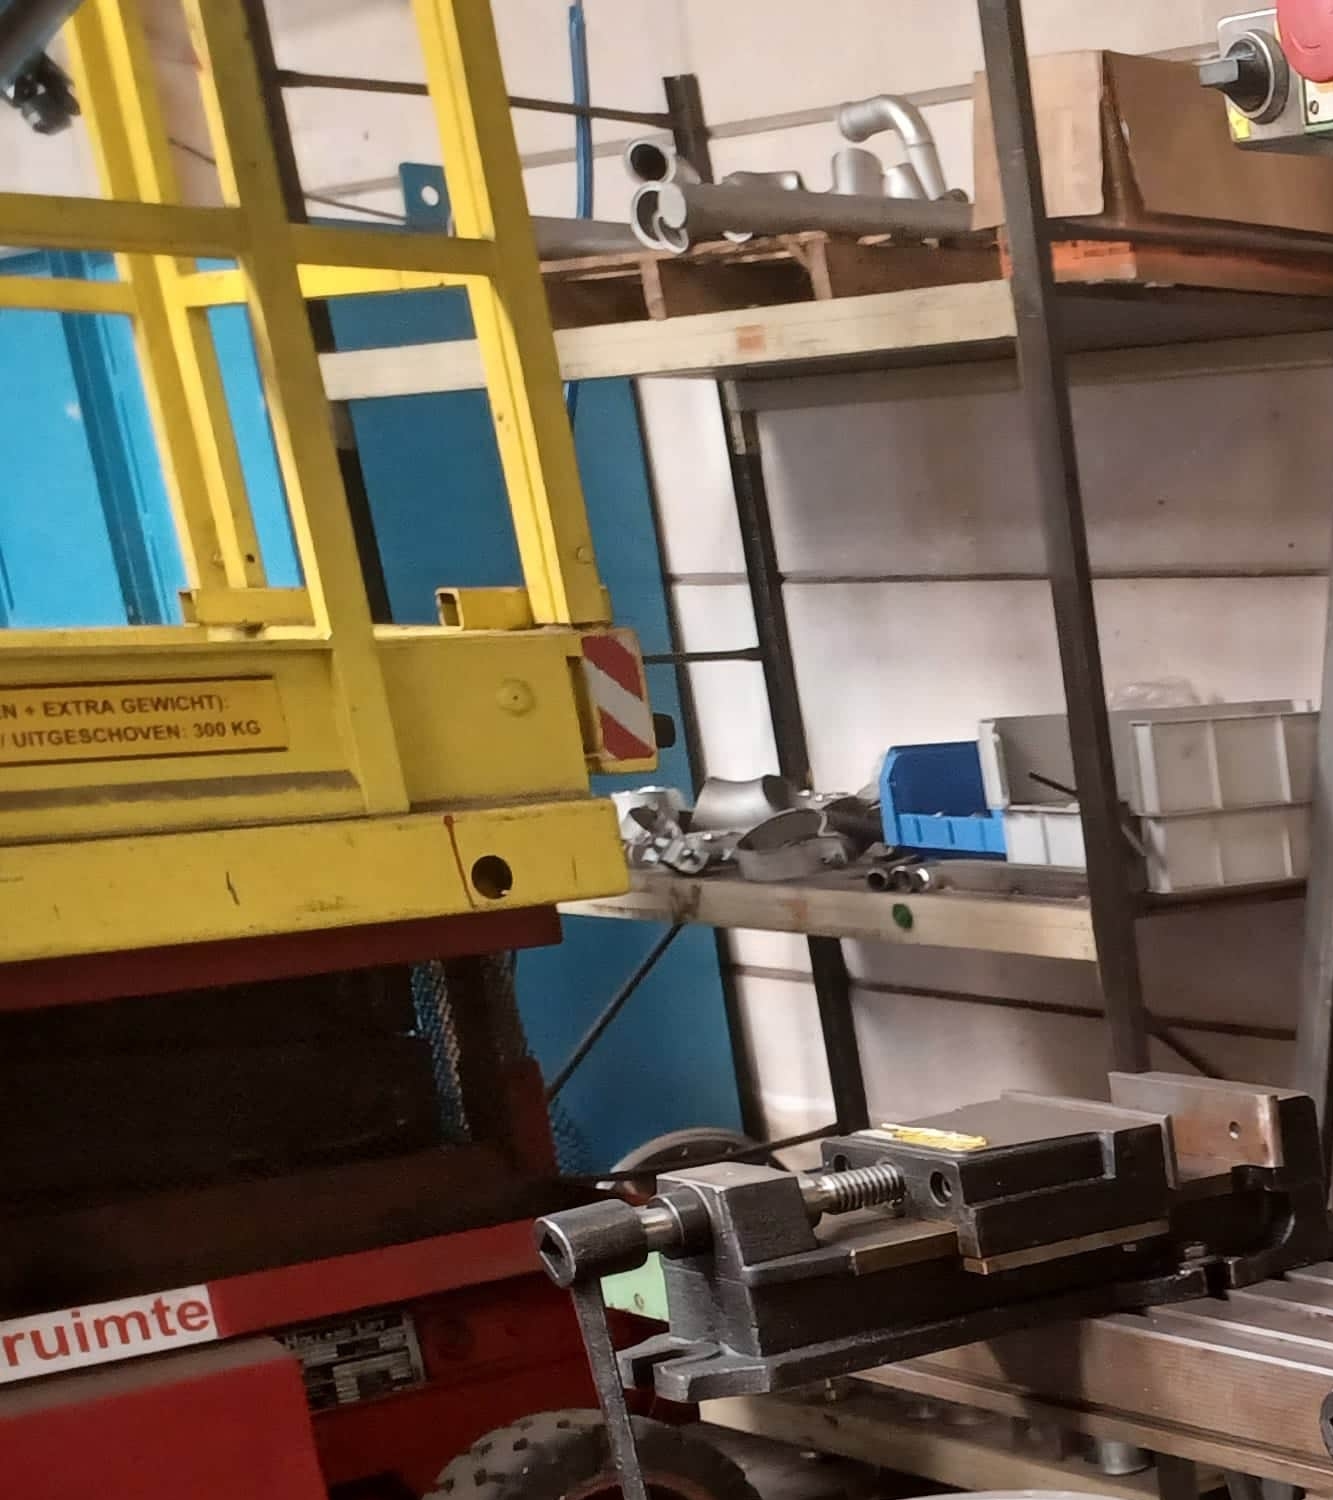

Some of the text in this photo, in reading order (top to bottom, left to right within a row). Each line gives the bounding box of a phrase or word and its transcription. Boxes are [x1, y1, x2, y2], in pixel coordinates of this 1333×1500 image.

[43, 699, 114, 717] EXTRA
[14, 723, 187, 748] UITGESCHOVEN:
[193, 722, 226, 738] 300
[231, 720, 262, 736] KG
[2, 1296, 210, 1366] ruimte
